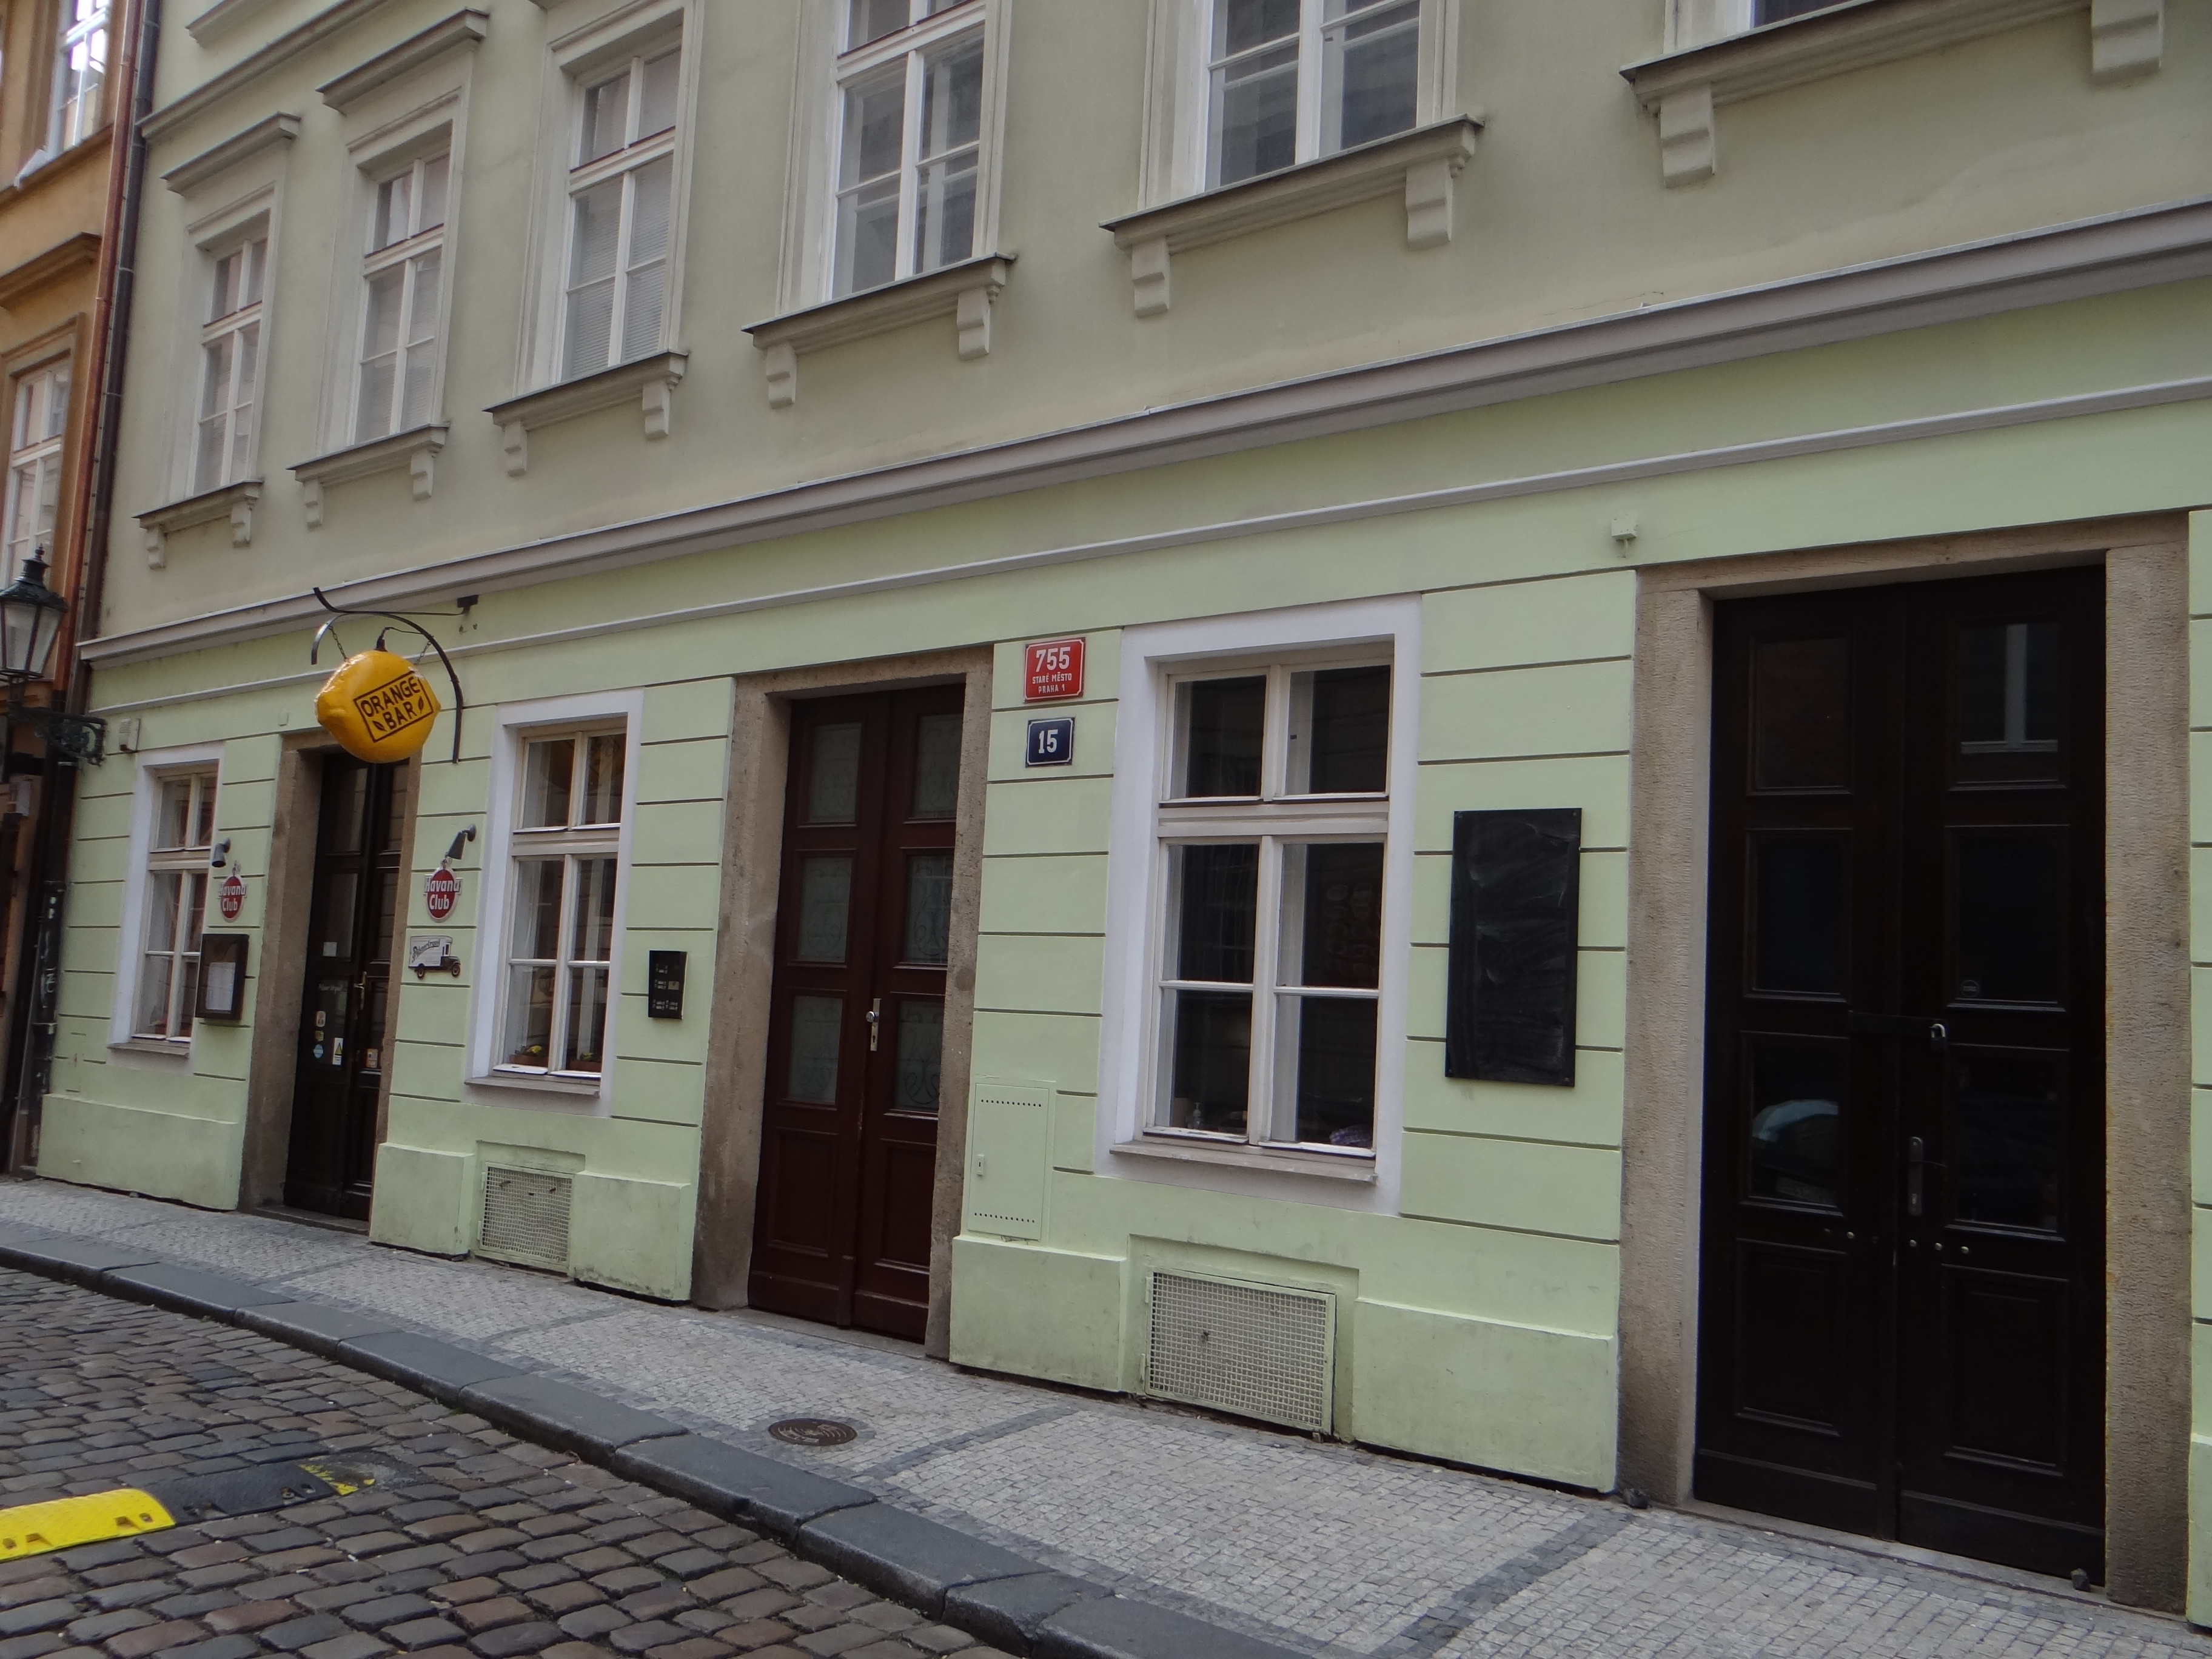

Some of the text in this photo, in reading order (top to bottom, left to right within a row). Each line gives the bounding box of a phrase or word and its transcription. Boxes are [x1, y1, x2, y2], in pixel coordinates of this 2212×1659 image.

[1036, 646, 1071, 672] 755
[1032, 671, 1072, 685] STARÉ MĚSTO
[360, 676, 420, 717] ORANGE
[1038, 683, 1065, 694] PRAHA 1
[383, 701, 417, 730] BAR
[1038, 729, 1059, 754] 15
[424, 877, 460, 892] Havana
[222, 897, 238, 912] Club
[429, 894, 450, 910] Club
